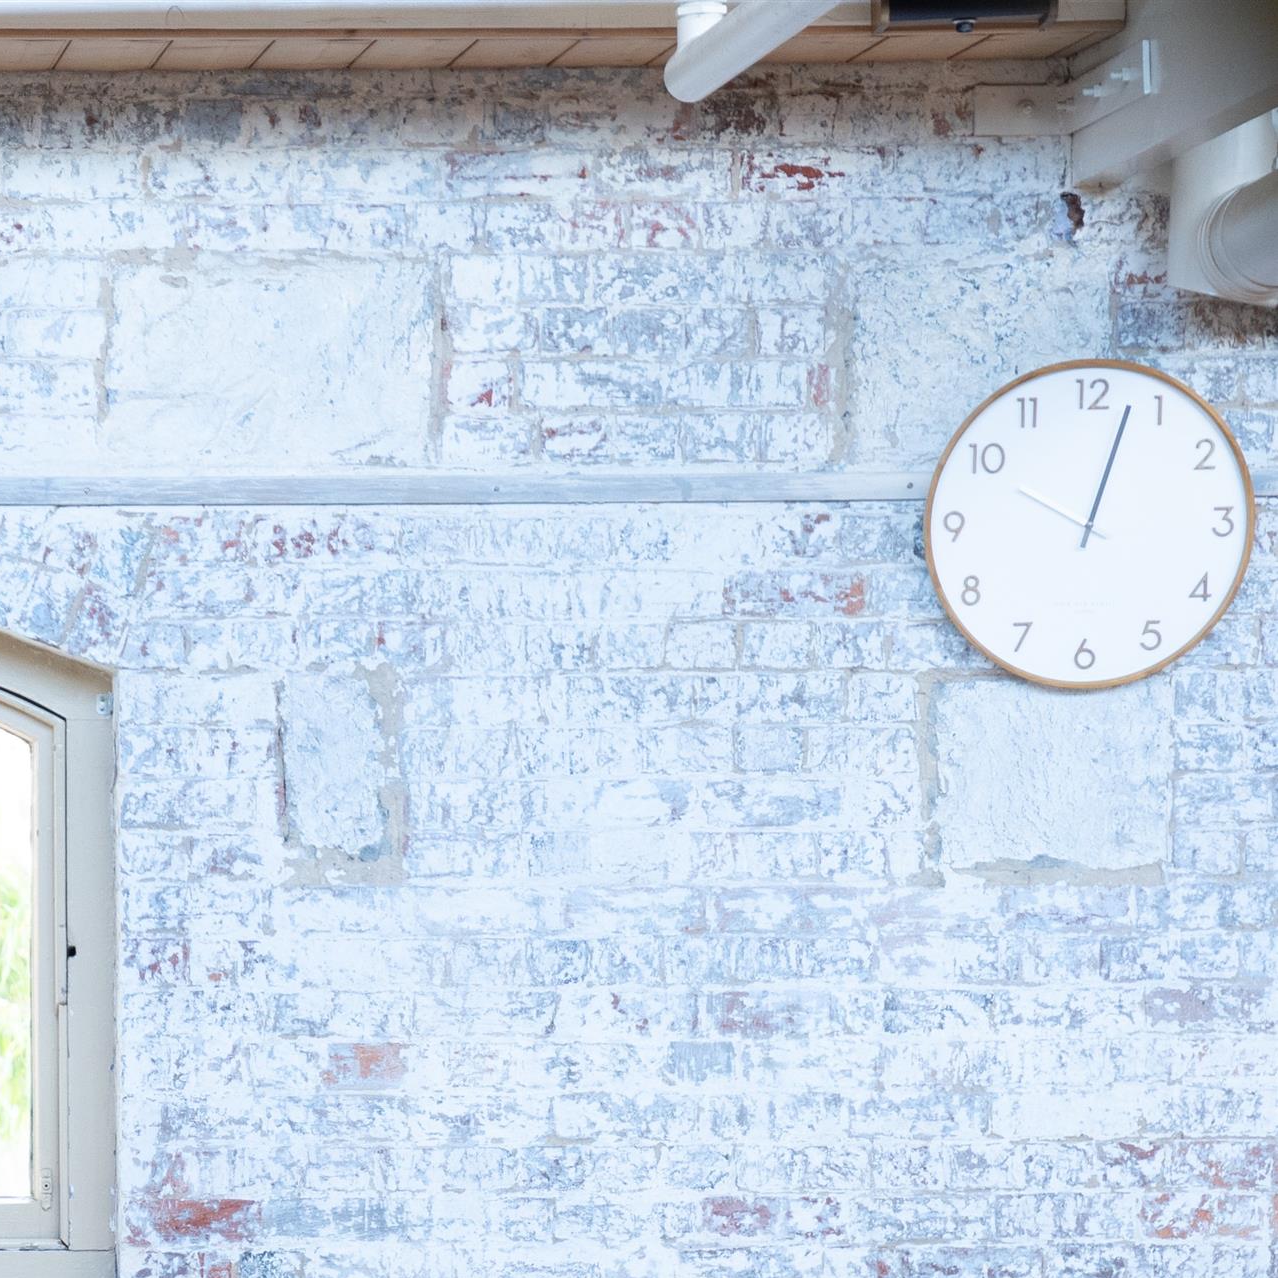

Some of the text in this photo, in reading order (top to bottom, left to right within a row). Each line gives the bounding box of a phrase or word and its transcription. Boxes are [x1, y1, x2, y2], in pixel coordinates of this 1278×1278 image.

[1076, 378, 1109, 410] 12
[1016, 397, 1037, 428] 11
[1154, 395, 1162, 426] 1
[969, 443, 1005, 474] 10
[1194, 438, 1215, 470] 2
[943, 511, 965, 542] 9
[1212, 506, 1234, 537] 3
[961, 575, 980, 606] 8
[1189, 572, 1212, 602] 4
[1013, 622, 1033, 652] 7
[1140, 620, 1162, 651] 5
[1074, 638, 1095, 670] 6
